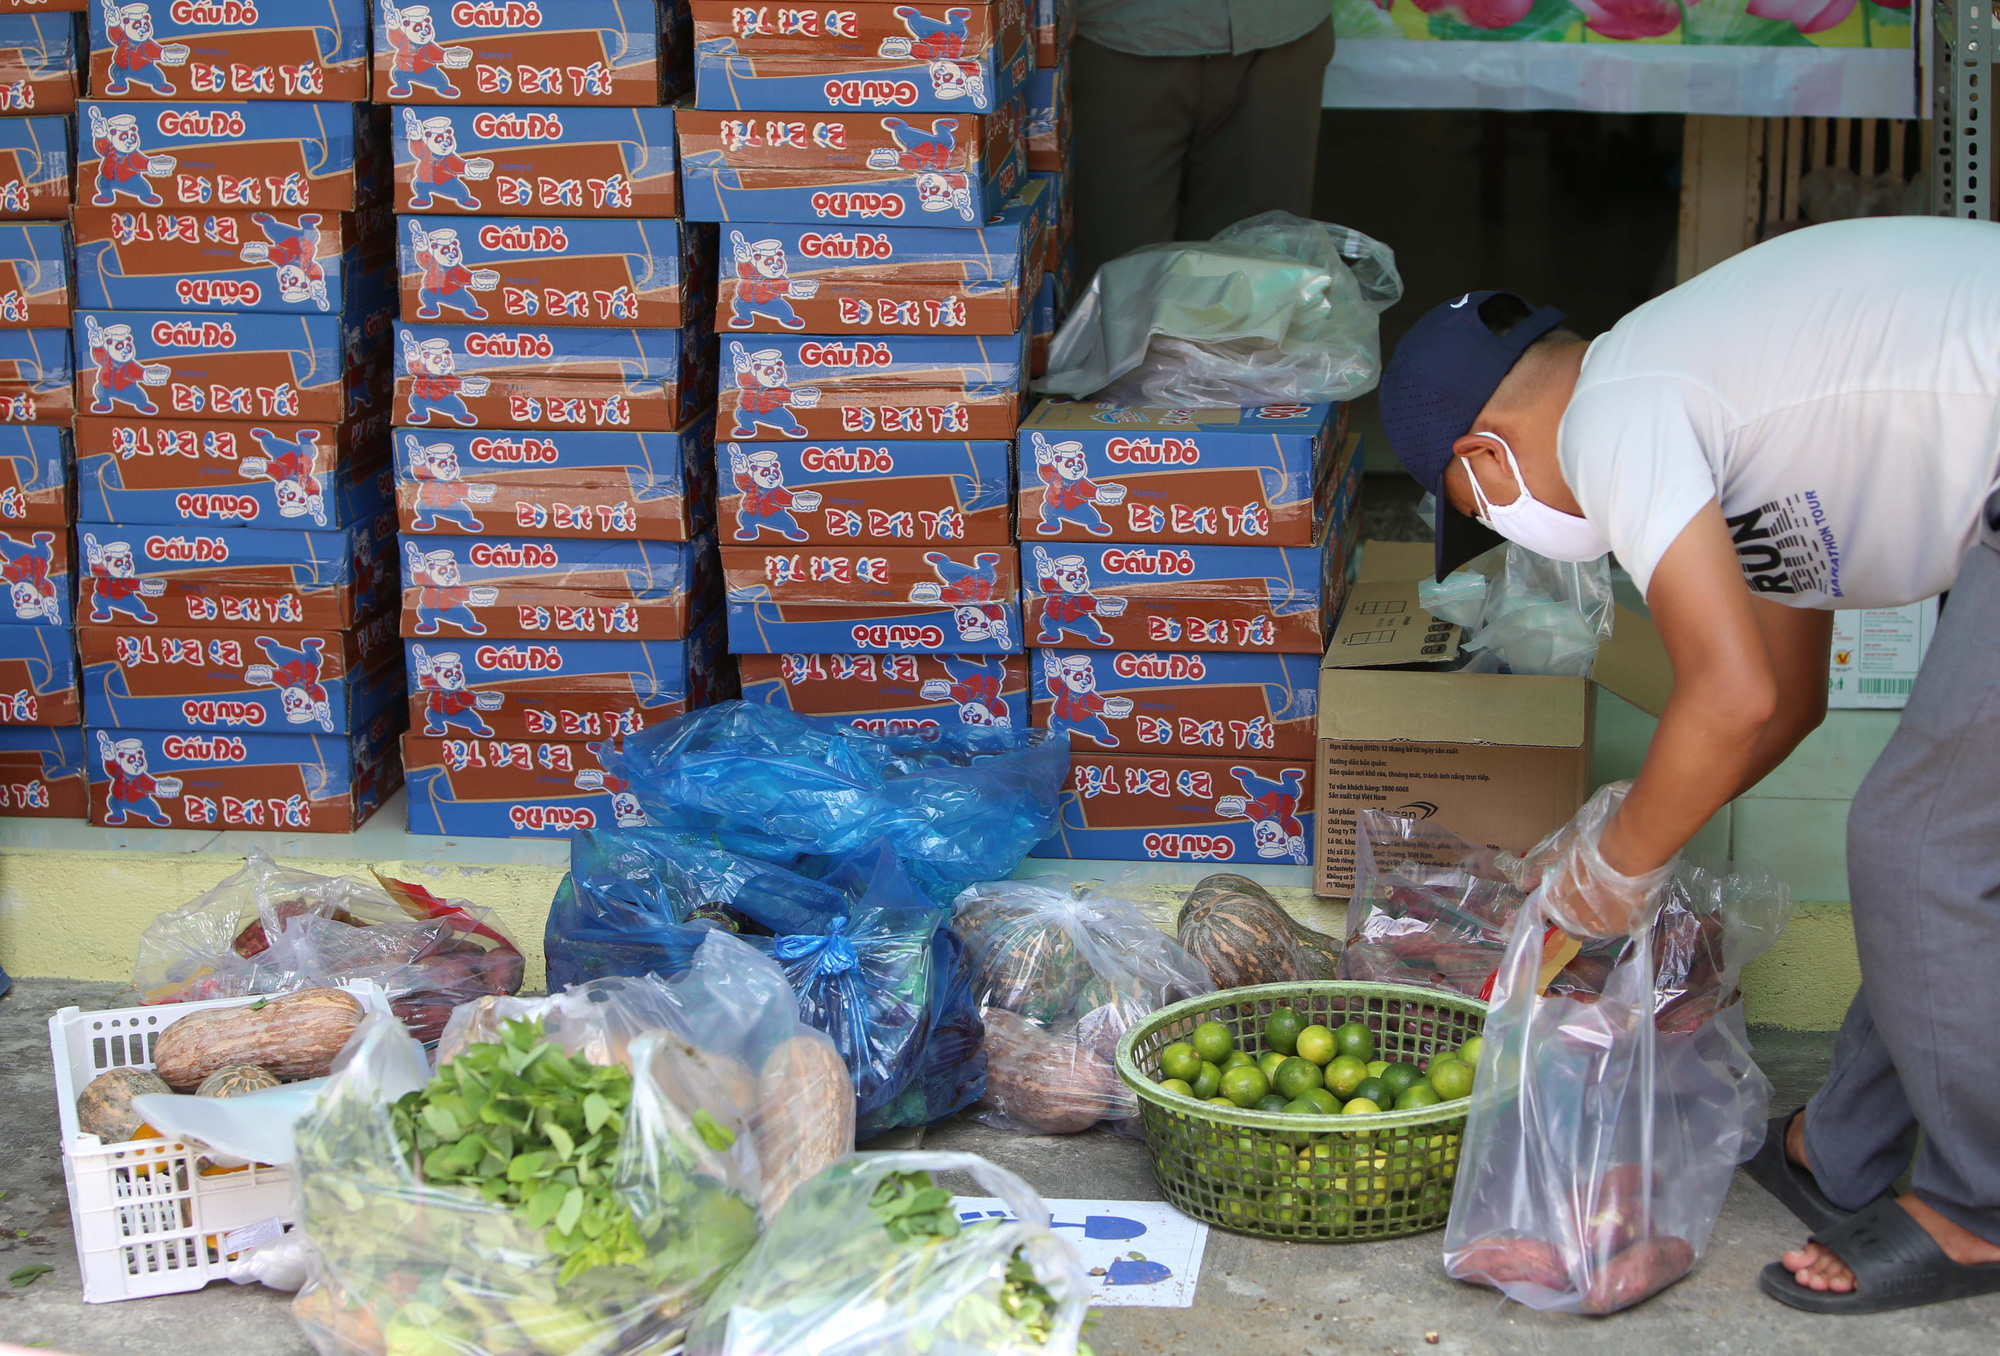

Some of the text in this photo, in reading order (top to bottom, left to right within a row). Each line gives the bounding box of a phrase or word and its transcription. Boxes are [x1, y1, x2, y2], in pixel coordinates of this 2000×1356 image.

[733, 7, 858, 39] Bò Bít Tết
[191, 60, 323, 95] Bò Bít Tết
[476, 61, 612, 96] Bò Bít Tết
[721, 119, 846, 151] Bò Bít Tết
[177, 172, 309, 207] Bò Bít Tết
[496, 174, 631, 208] Bò Bít Tết
[111, 212, 239, 245] Bò Bít Tết
[504, 286, 638, 319] Bò Bít Tết
[839, 296, 966, 327] Bò Bít Tết
[172, 383, 298, 416] Bò Bít Tết
[510, 394, 630, 426] Bò Bít Tết
[841, 402, 968, 434] Bò Bít Tết
[112, 427, 237, 460] Bò Bít Tết
[516, 501, 636, 531] Bò Bít Tết
[825, 507, 964, 540] Bò Bít Tết
[1127, 502, 1268, 536] Bò Bít Tết
[1725, 507, 1796, 594] RUN
[1805, 489, 1845, 598] MARATHON TOUR
[765, 555, 889, 586] Bò Bít Tết
[186, 594, 302, 623] Bò Bít Tết
[518, 603, 638, 633] Bò Bít Tết
[1148, 615, 1274, 645] Bò Bít Tết
[116, 636, 243, 667] Bò Bít Tết
[781, 653, 919, 685] Bò Bít Tết
[523, 707, 644, 737] Bò Bít Tết
[1136, 716, 1274, 749] Bò Bít Tết
[443, 740, 573, 772] Bò Bít Tết
[12, 780, 49, 809] Tết
[1075, 765, 1213, 799] Bò Bít Tết
[1361, 793, 1373, 801] Việt
[184, 795, 310, 827] Bò Bít Tết
